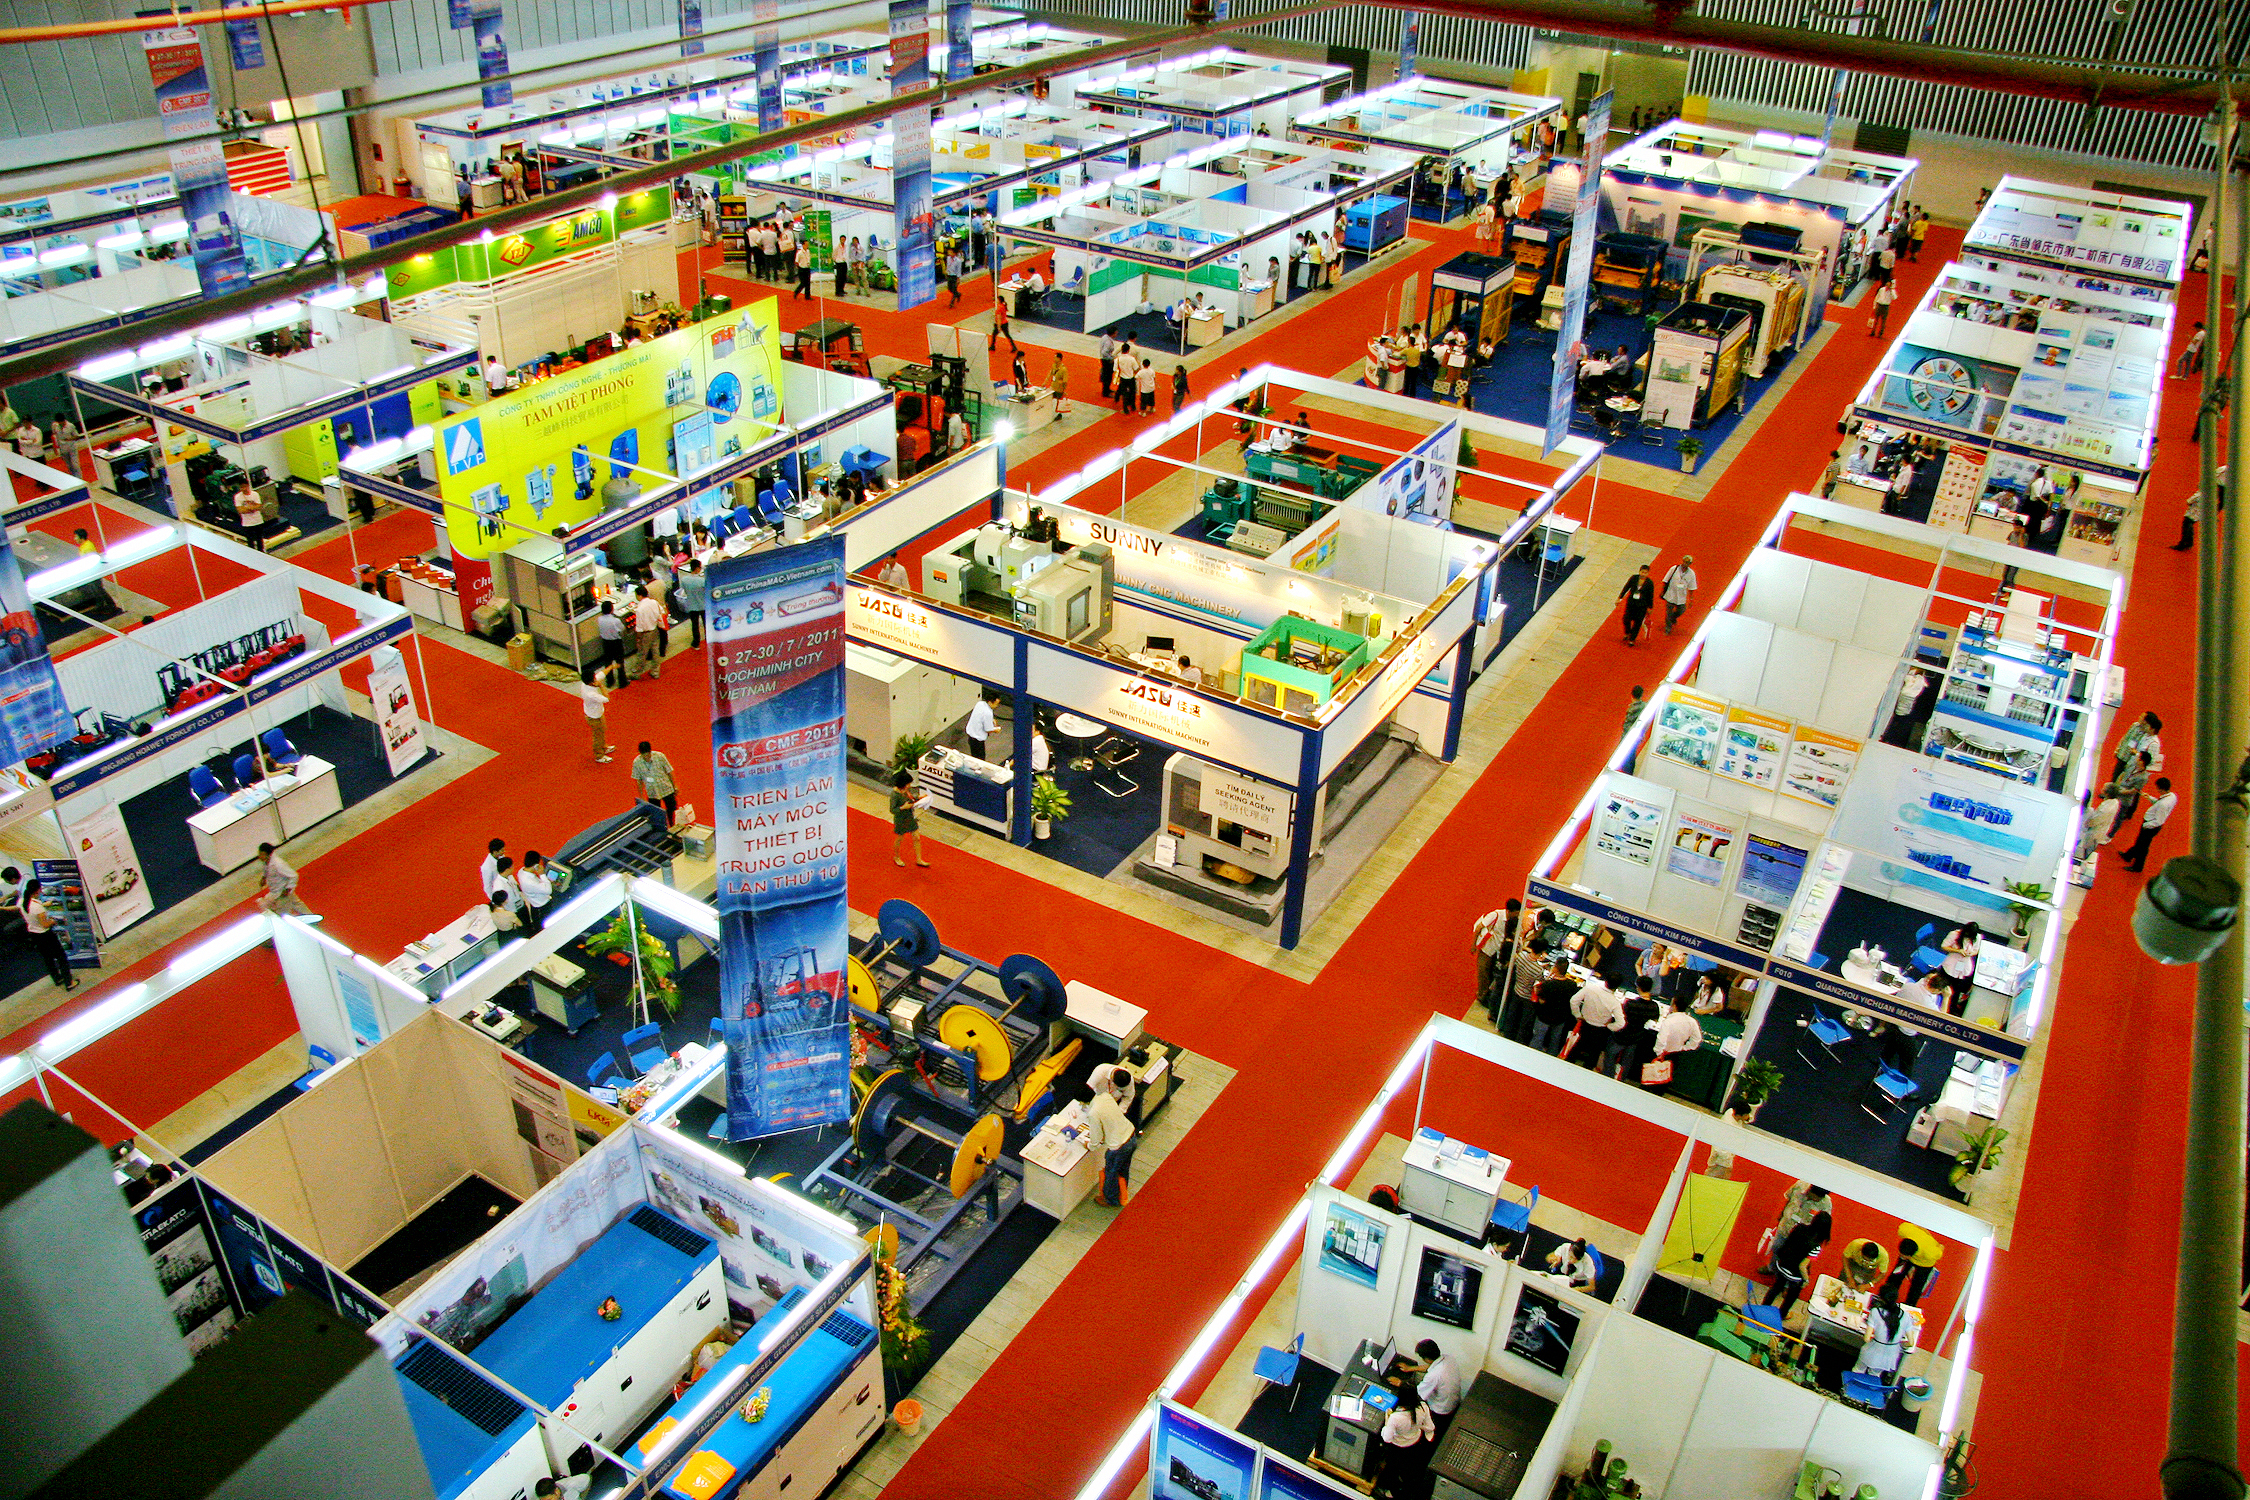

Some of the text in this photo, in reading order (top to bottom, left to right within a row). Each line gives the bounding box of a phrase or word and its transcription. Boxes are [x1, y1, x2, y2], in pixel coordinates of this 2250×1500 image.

[574, 217, 602, 240] AMCO
[590, 374, 635, 402] PHONG
[451, 452, 485, 476] TVP
[1090, 522, 1163, 556] SUNNY
[724, 563, 833, 596] www.ChinaMAC-Vietnam.com
[1115, 573, 1241, 620] UNNY CNC MACHINERY
[735, 644, 774, 665] 27-30
[787, 639, 795, 651] 7
[807, 627, 838, 647] 2011
[852, 622, 939, 655] SUNNY INTERNATIONAL MACHINERY
[279, 668, 311, 688] JINGJIANG
[335, 644, 364, 662] FORKLIFT
[375, 631, 388, 641] LTD
[718, 650, 823, 684] HOCHIMINH CITY
[719, 681, 777, 700] VIETNAM
[99, 754, 136, 775] JINGJIANG
[165, 725, 197, 743] FORKLIFT
[211, 709, 225, 721] LTD
[765, 734, 800, 752] CMF
[804, 724, 838, 743] 2011
[1108, 707, 1210, 747] SUNNY INTERNATIONAL MACHINERY
[1214, 788, 1275, 813] SEEKING AGENT
[720, 855, 786, 875] TRUNG
[820, 865, 839, 880] 10
[1532, 885, 1550, 897] F009
[1607, 910, 1630, 924] CÔNG
[1631, 918, 1642, 928] TY
[1642, 922, 1664, 935] TNHH
[1664, 929, 1680, 940] KIM
[1774, 967, 1793, 979] F010
[1815, 980, 1860, 1001] QUANZHOU
[1859, 995, 1896, 1014] YICHUAN
[1896, 1006, 1943, 1030] MACHINERY
[1962, 1028, 1981, 1041] LTD
[655, 1460, 672, 1478] E003
[696, 1405, 725, 1437] TAIZHOU
[726, 1381, 750, 1407] KAIHUA
[750, 1358, 773, 1383] DIESEL
[773, 1318, 816, 1360] GENERATORS
[815, 1302, 828, 1319] SET
[840, 1276, 853, 1292] LTD
